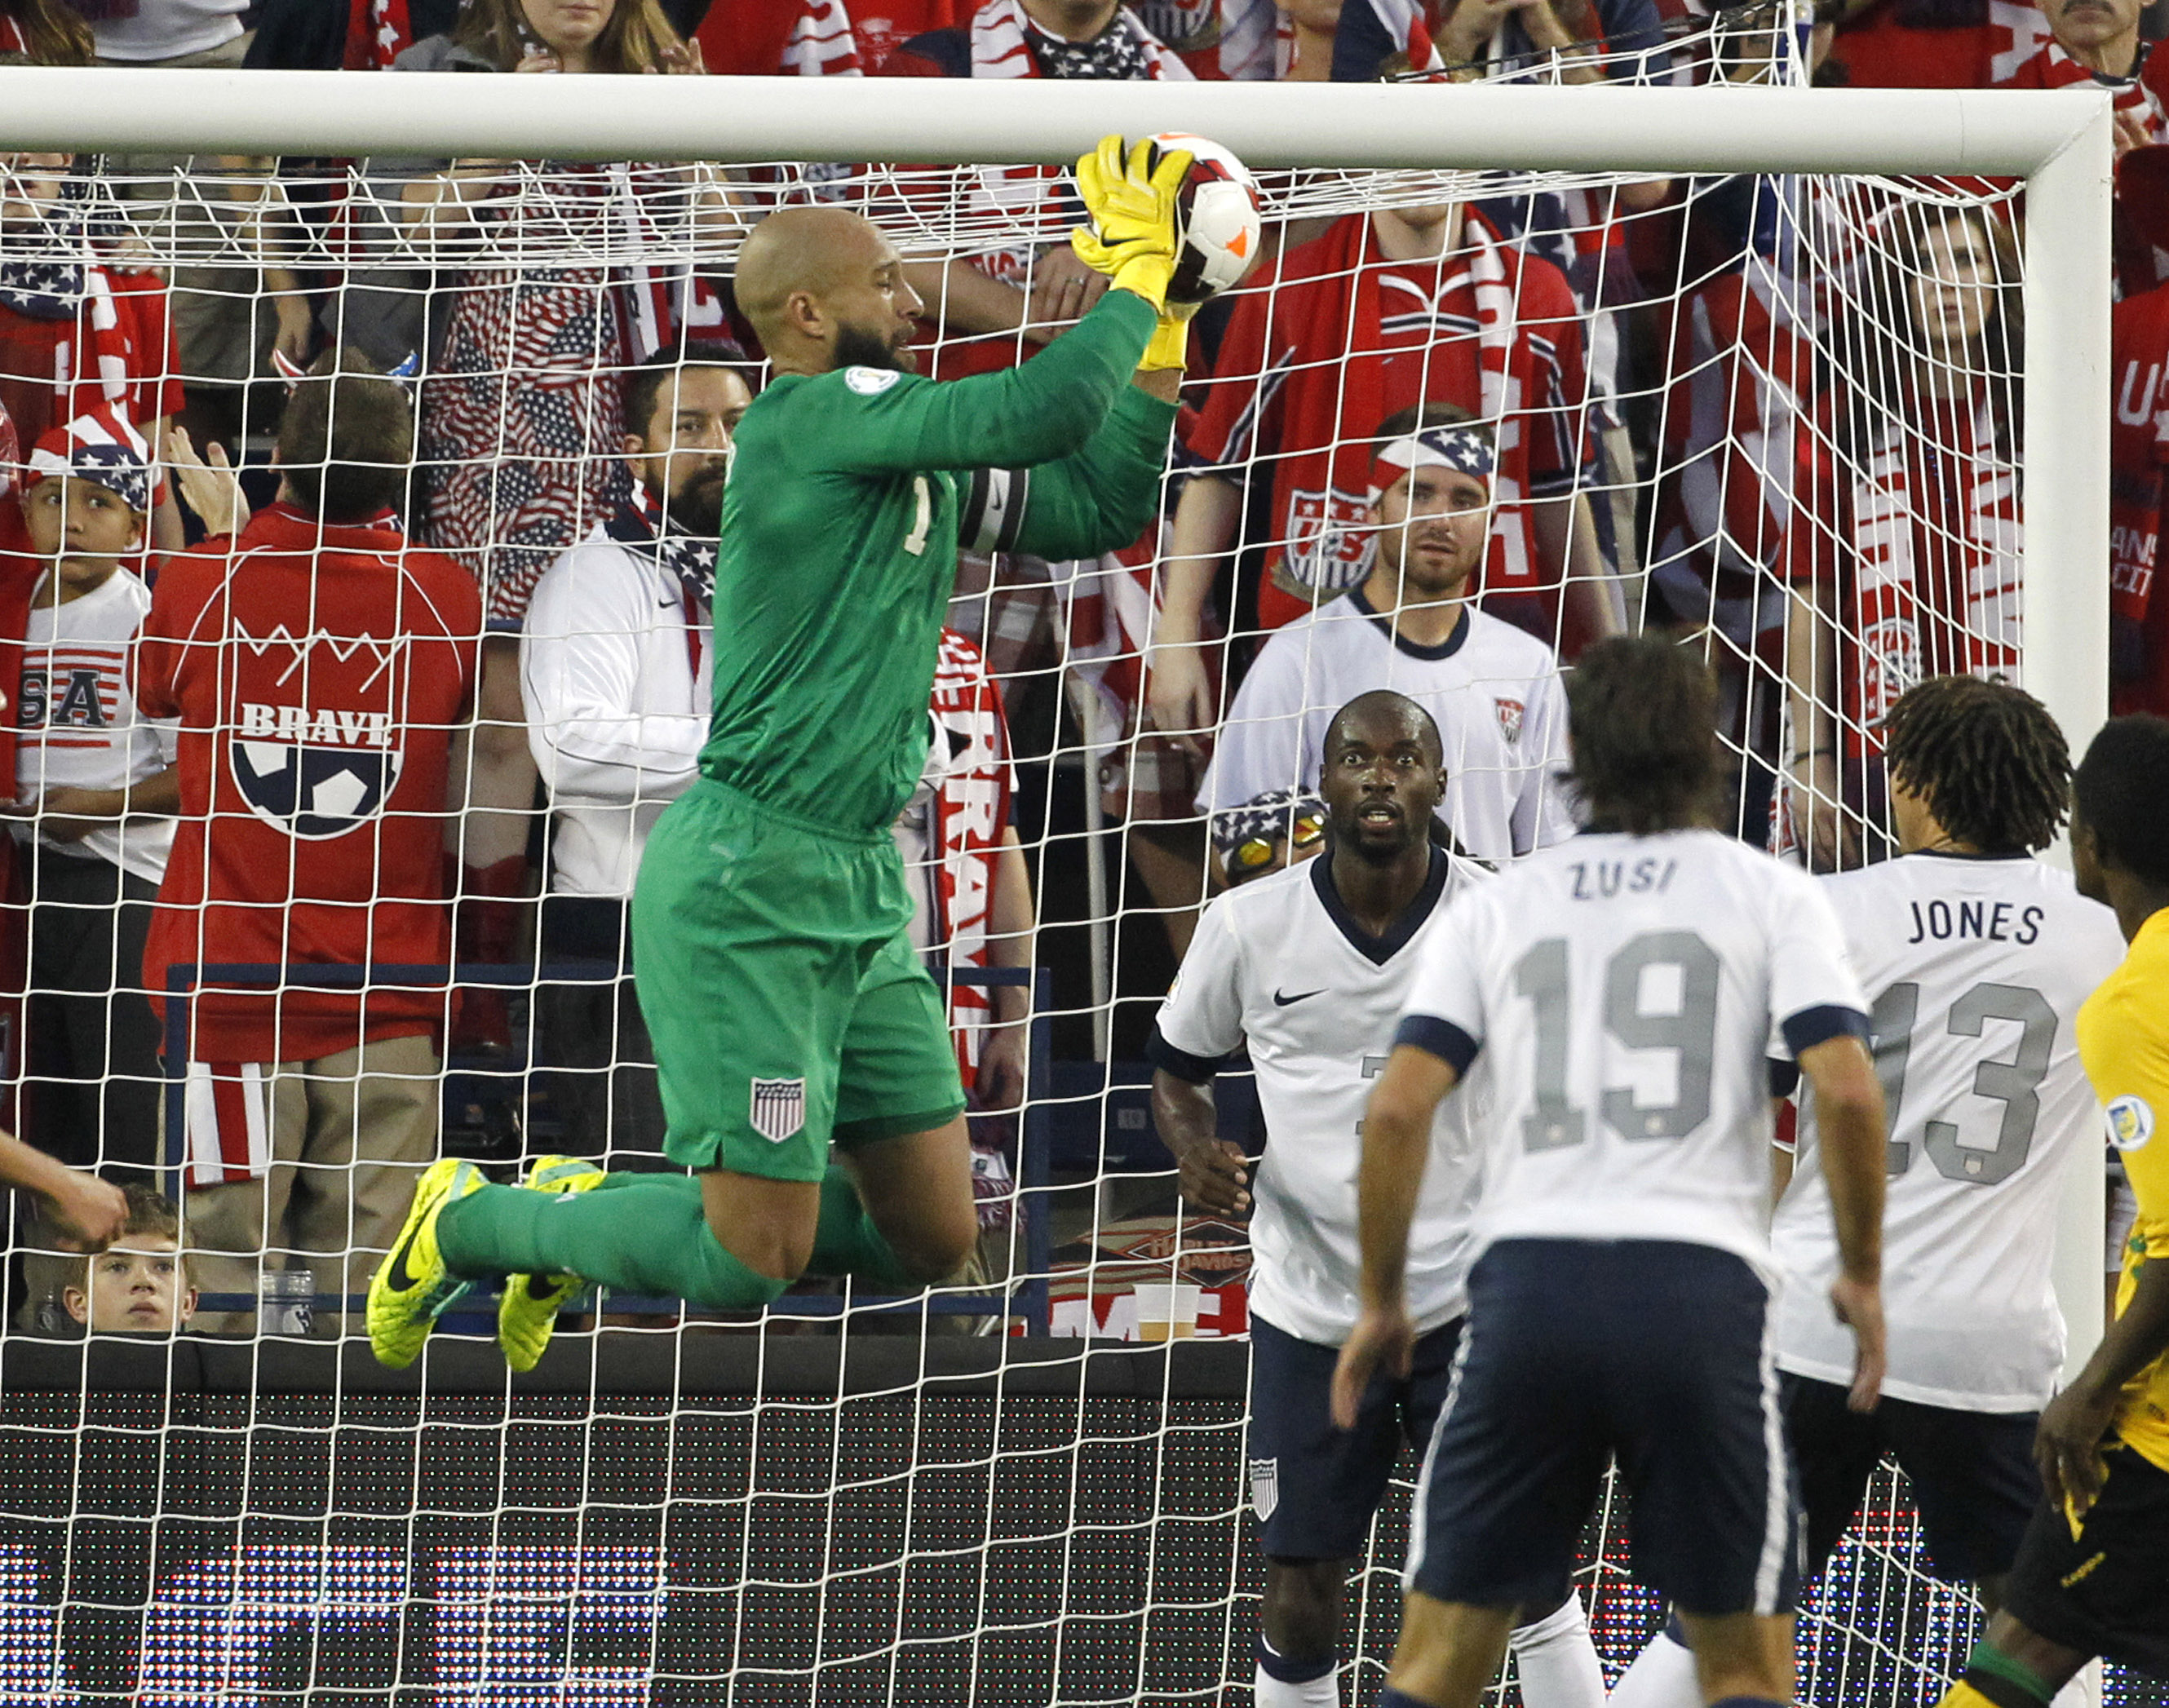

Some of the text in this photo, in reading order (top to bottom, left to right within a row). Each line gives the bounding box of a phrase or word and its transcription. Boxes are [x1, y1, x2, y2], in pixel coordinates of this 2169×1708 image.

[903, 476, 931, 556] 1
[240, 702, 393, 746] BRAVE
[1566, 857, 1677, 900] ZUSI
[1908, 900, 2044, 945] JONES
[1512, 930, 1720, 1154] 19
